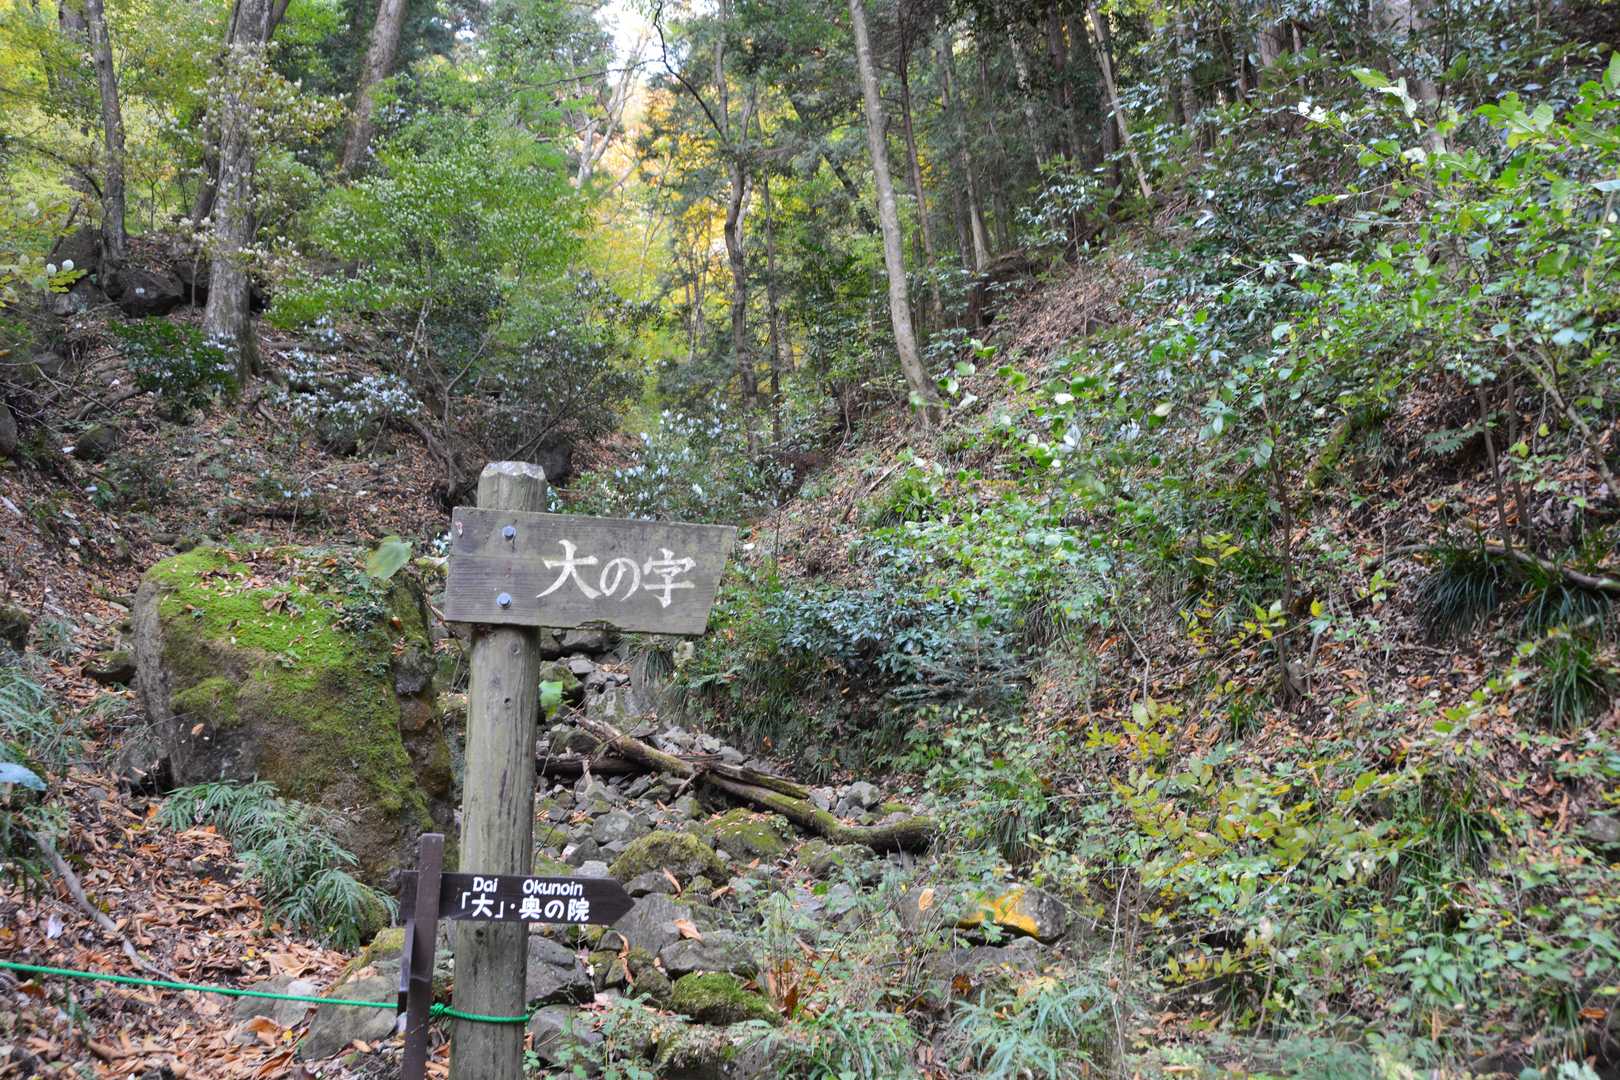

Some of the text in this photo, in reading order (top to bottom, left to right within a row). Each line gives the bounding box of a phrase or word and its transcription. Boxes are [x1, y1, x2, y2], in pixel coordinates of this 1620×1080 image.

[536, 539, 697, 608] 大の字
[472, 876, 584, 896] Dai Okunoin
